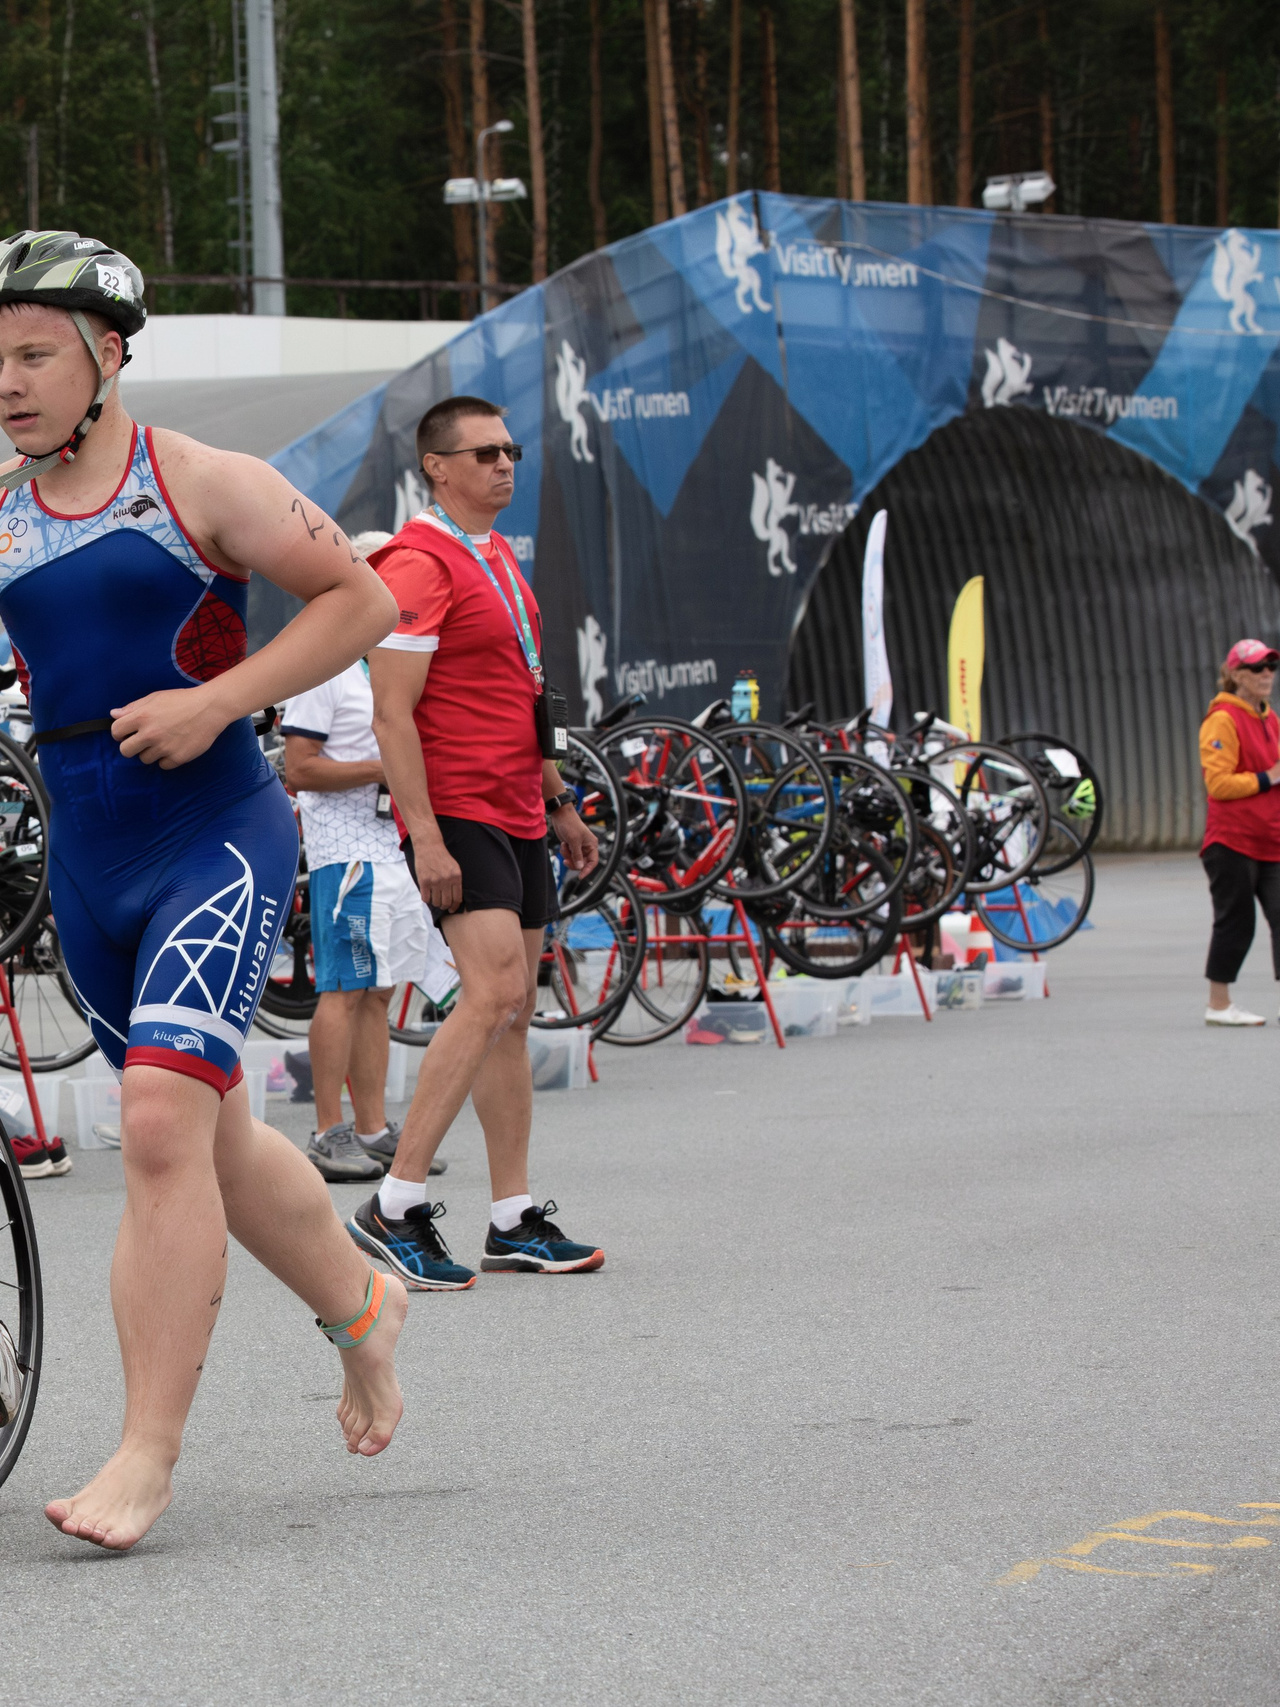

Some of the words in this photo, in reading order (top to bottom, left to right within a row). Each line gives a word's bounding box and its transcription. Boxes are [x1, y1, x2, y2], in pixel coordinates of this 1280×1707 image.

[103, 271, 120, 293] 22
[1043, 384, 1179, 425] VisitTyumen
[112, 500, 152, 520] kiwami
[229, 893, 279, 1023] kiwami
[152, 1029, 200, 1050] kiwami
